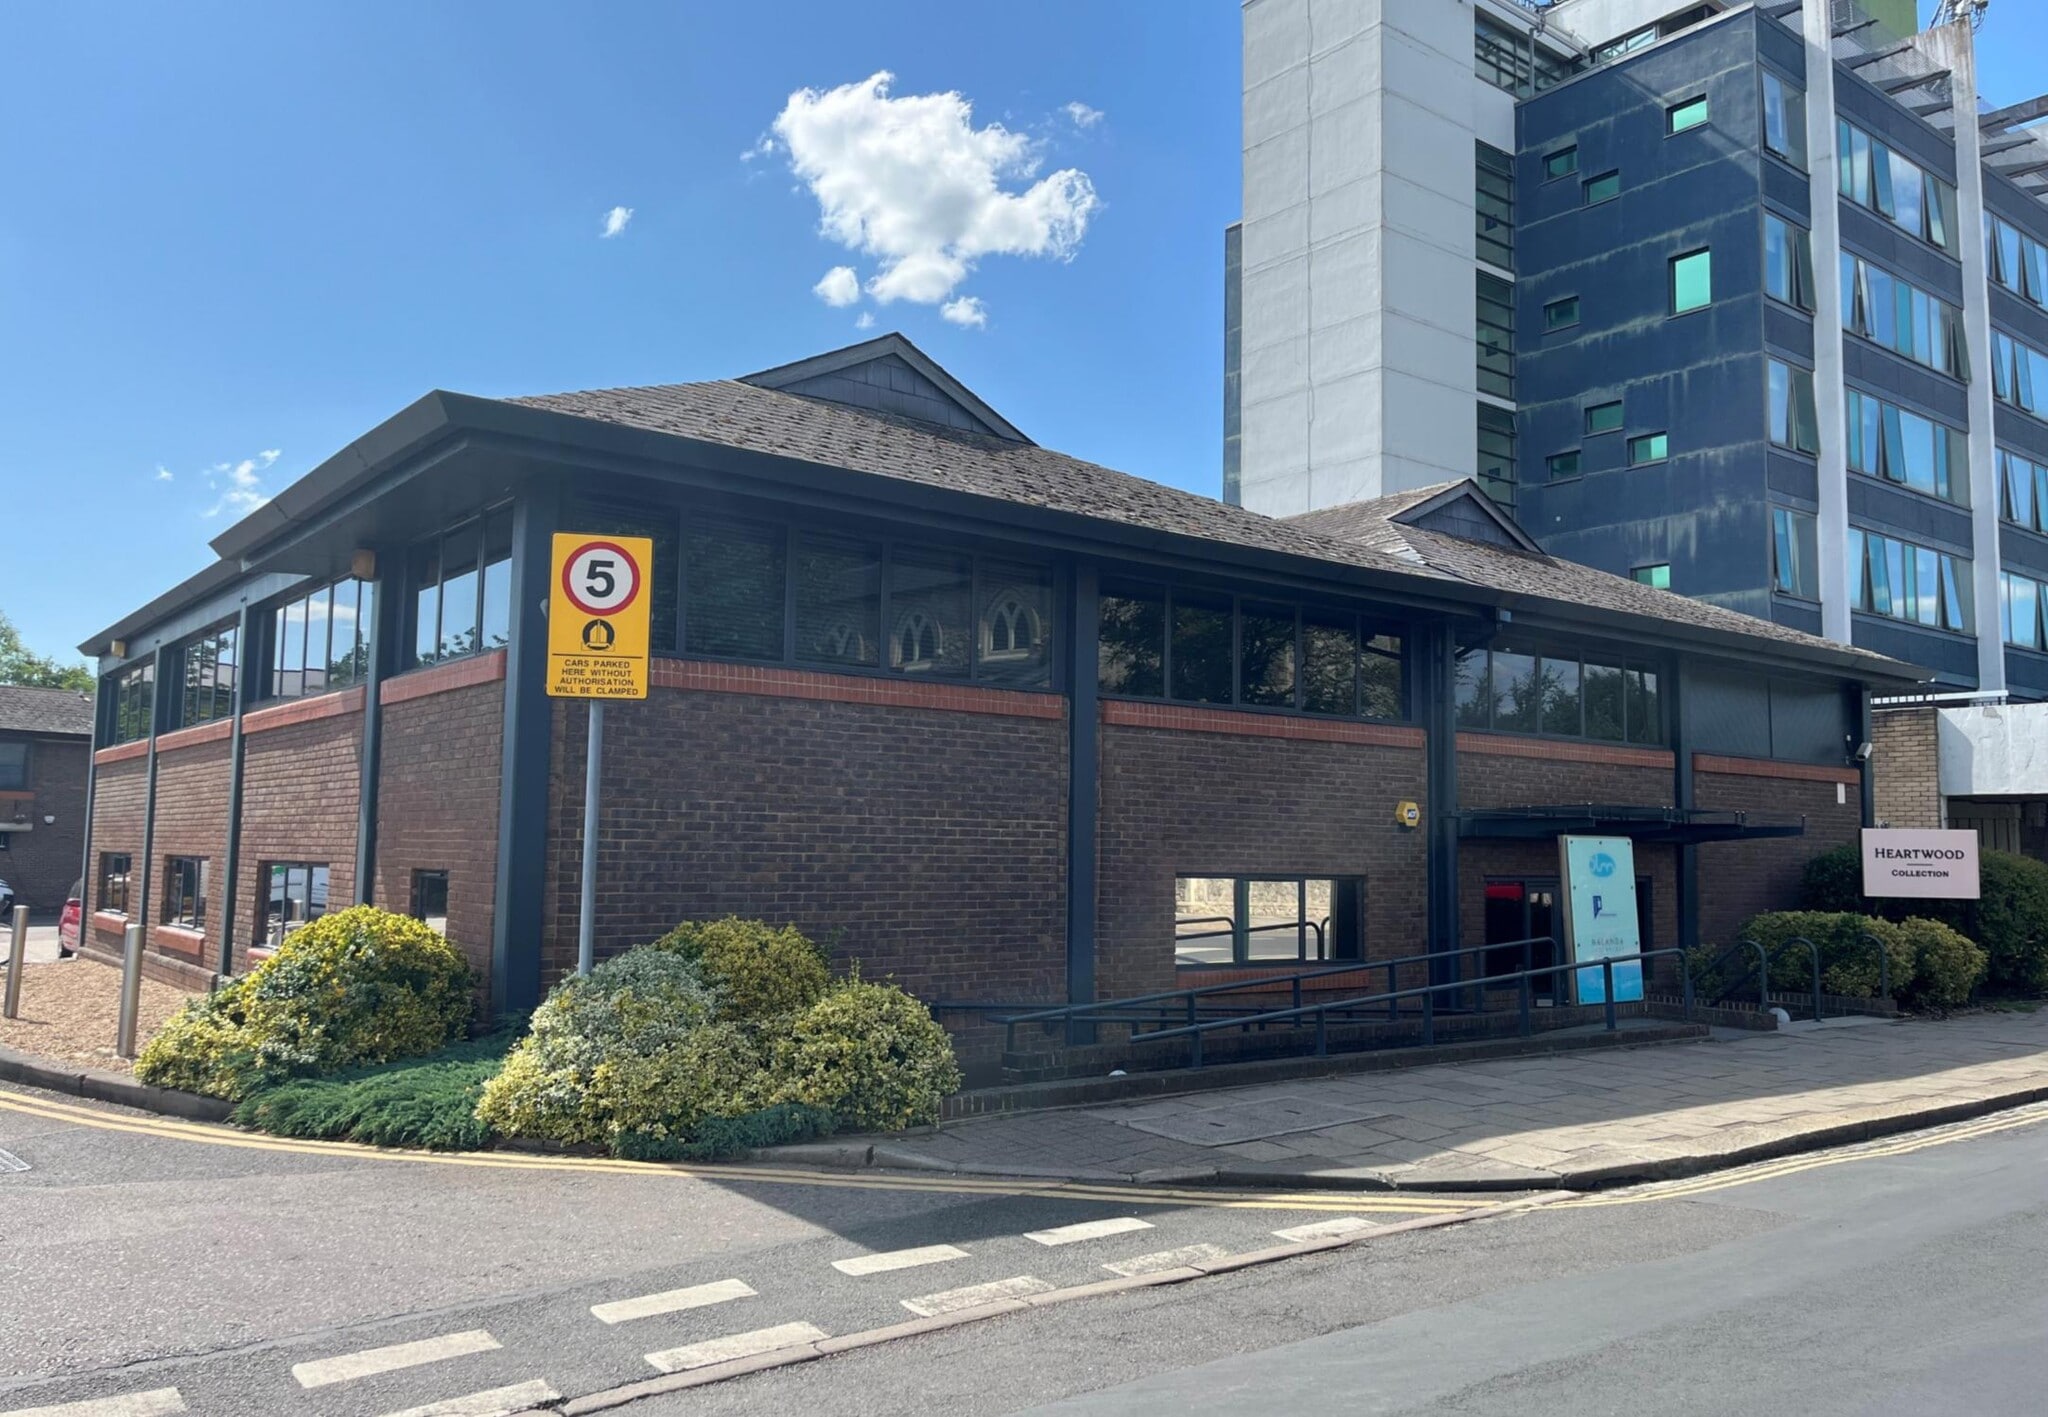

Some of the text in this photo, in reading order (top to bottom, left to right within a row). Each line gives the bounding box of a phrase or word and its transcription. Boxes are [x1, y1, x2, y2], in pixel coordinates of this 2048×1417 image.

[586, 560, 615, 598] 5
[564, 659, 630, 669] CARS PARKED
[562, 668, 632, 677] HERE WITHOUT
[560, 677, 634, 686] AUTHORISATION
[554, 686, 639, 696] WILL BE CLAMPED
[1875, 848, 1965, 860] HEARTWOOD
[1891, 869, 1949, 878] COLLECTION
